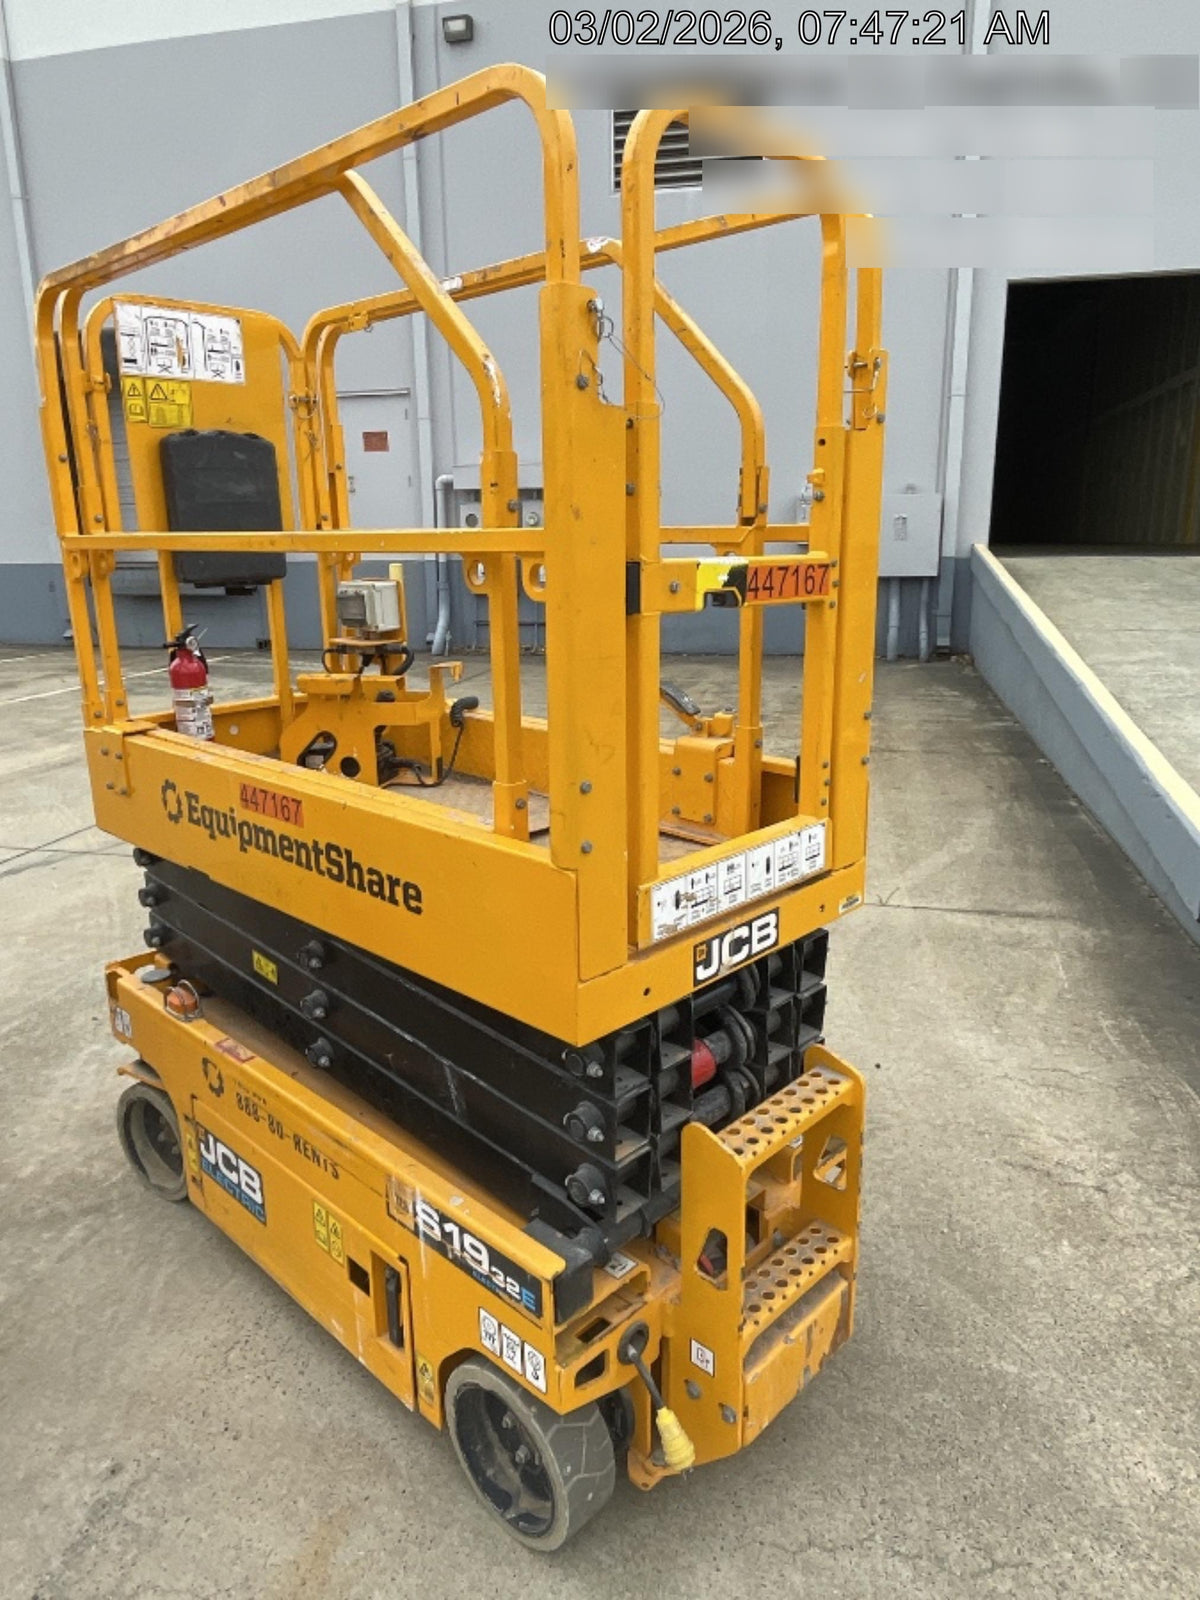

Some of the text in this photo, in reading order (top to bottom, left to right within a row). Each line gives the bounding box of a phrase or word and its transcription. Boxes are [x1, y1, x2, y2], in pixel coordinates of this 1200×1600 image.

[747, 564, 830, 599] 447167
[239, 783, 303, 826] 447167
[184, 790, 424, 915] EquipmentShare
[695, 912, 778, 981] JCB
[200, 1132, 264, 1205] JCB
